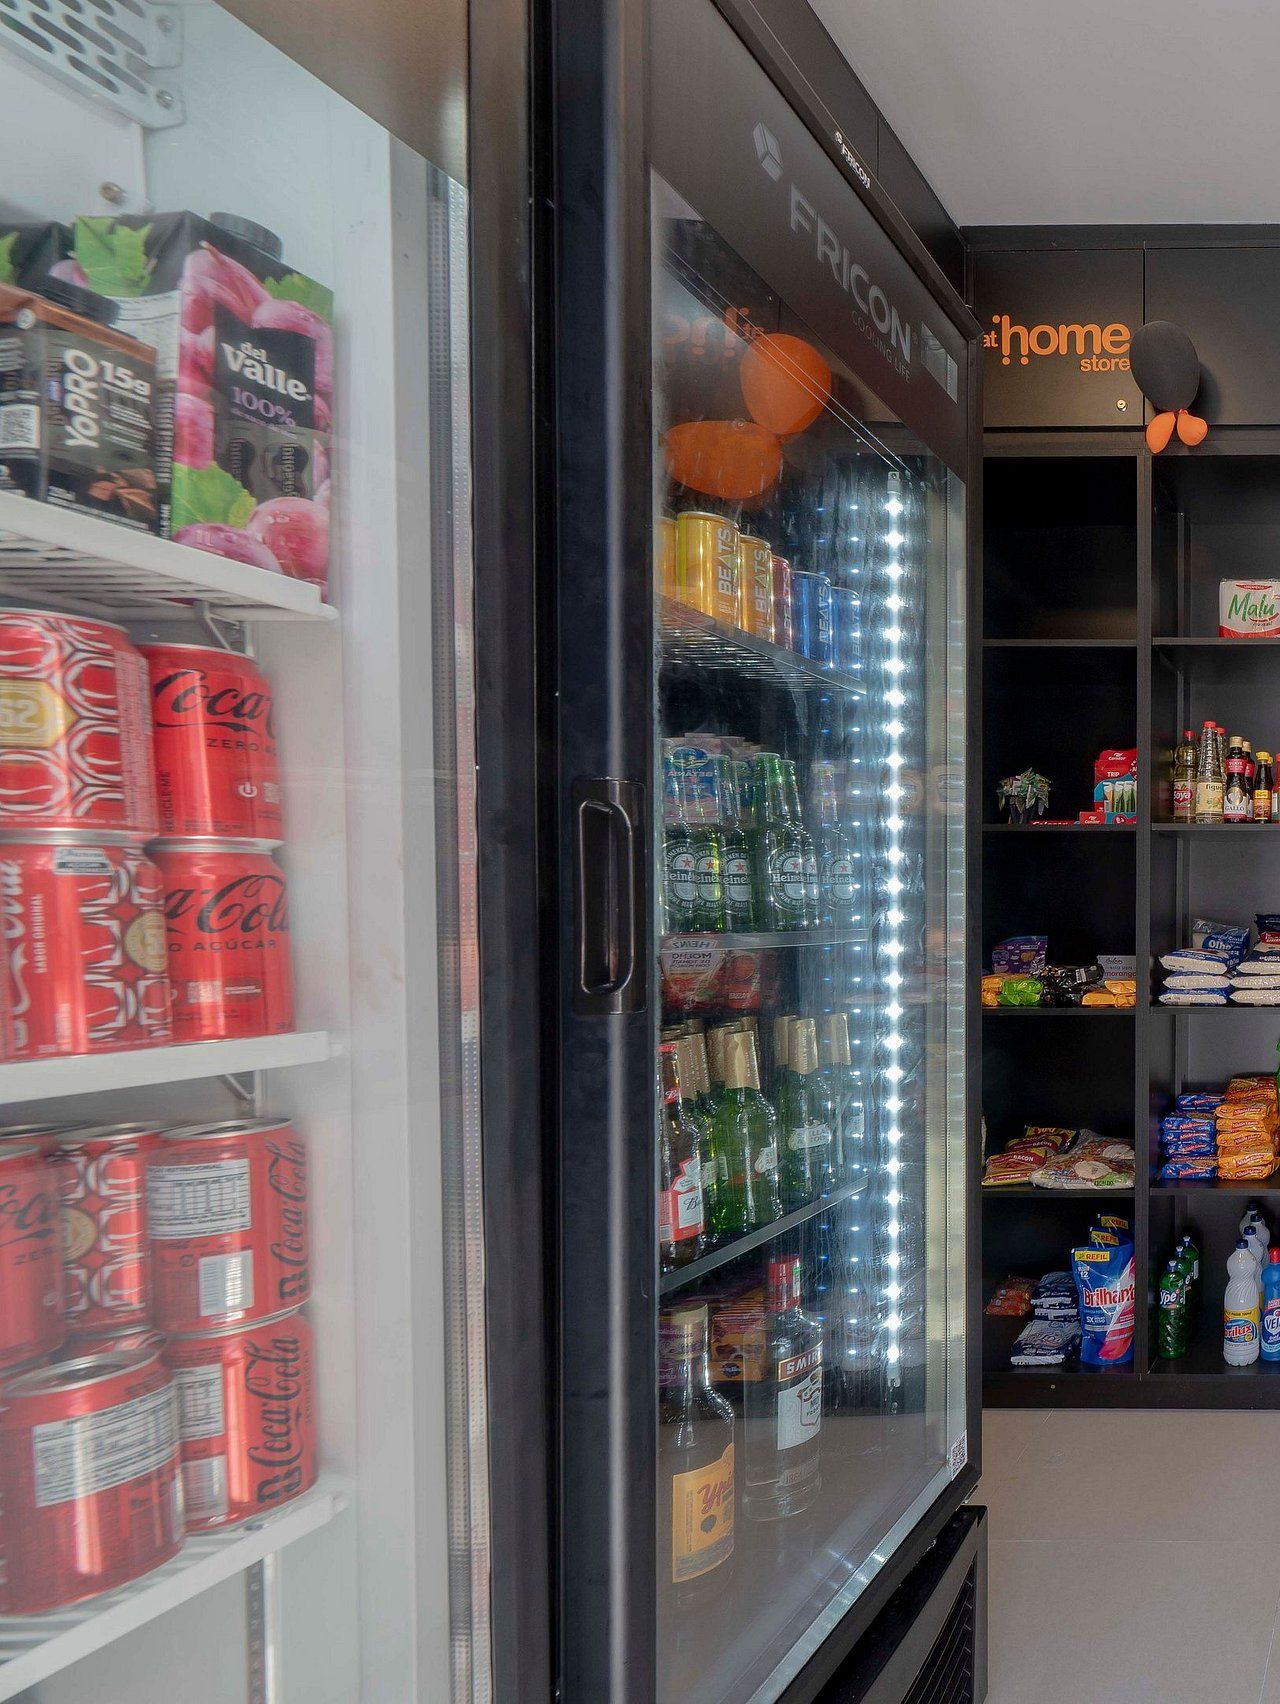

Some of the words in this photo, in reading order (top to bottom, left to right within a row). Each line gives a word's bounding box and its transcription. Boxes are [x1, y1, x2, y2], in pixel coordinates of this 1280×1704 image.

[790, 183, 911, 364] FRICON
[240, 341, 268, 363] del
[983, 330, 999, 348] at
[1001, 315, 1131, 358] home
[1100, 355, 1131, 372] store
[231, 386, 296, 428] 100%
[718, 526, 733, 597] BEATS
[754, 549, 768, 613] BEATS
[1228, 593, 1276, 622] Malu
[207, 737, 260, 752] ZERO
[30, 893, 46, 940] ORIGINAL
[33, 940, 48, 974] SABOR
[192, 938, 277, 953] AÇÚCAR
[1208, 939, 1232, 951] Olho
[1013, 1154, 1034, 1162] BACON
[264, 1139, 309, 1268] Coca-Cola
[1085, 1253, 1107, 1261] REFIL
[244, 1337, 302, 1467] Coca-Cola
